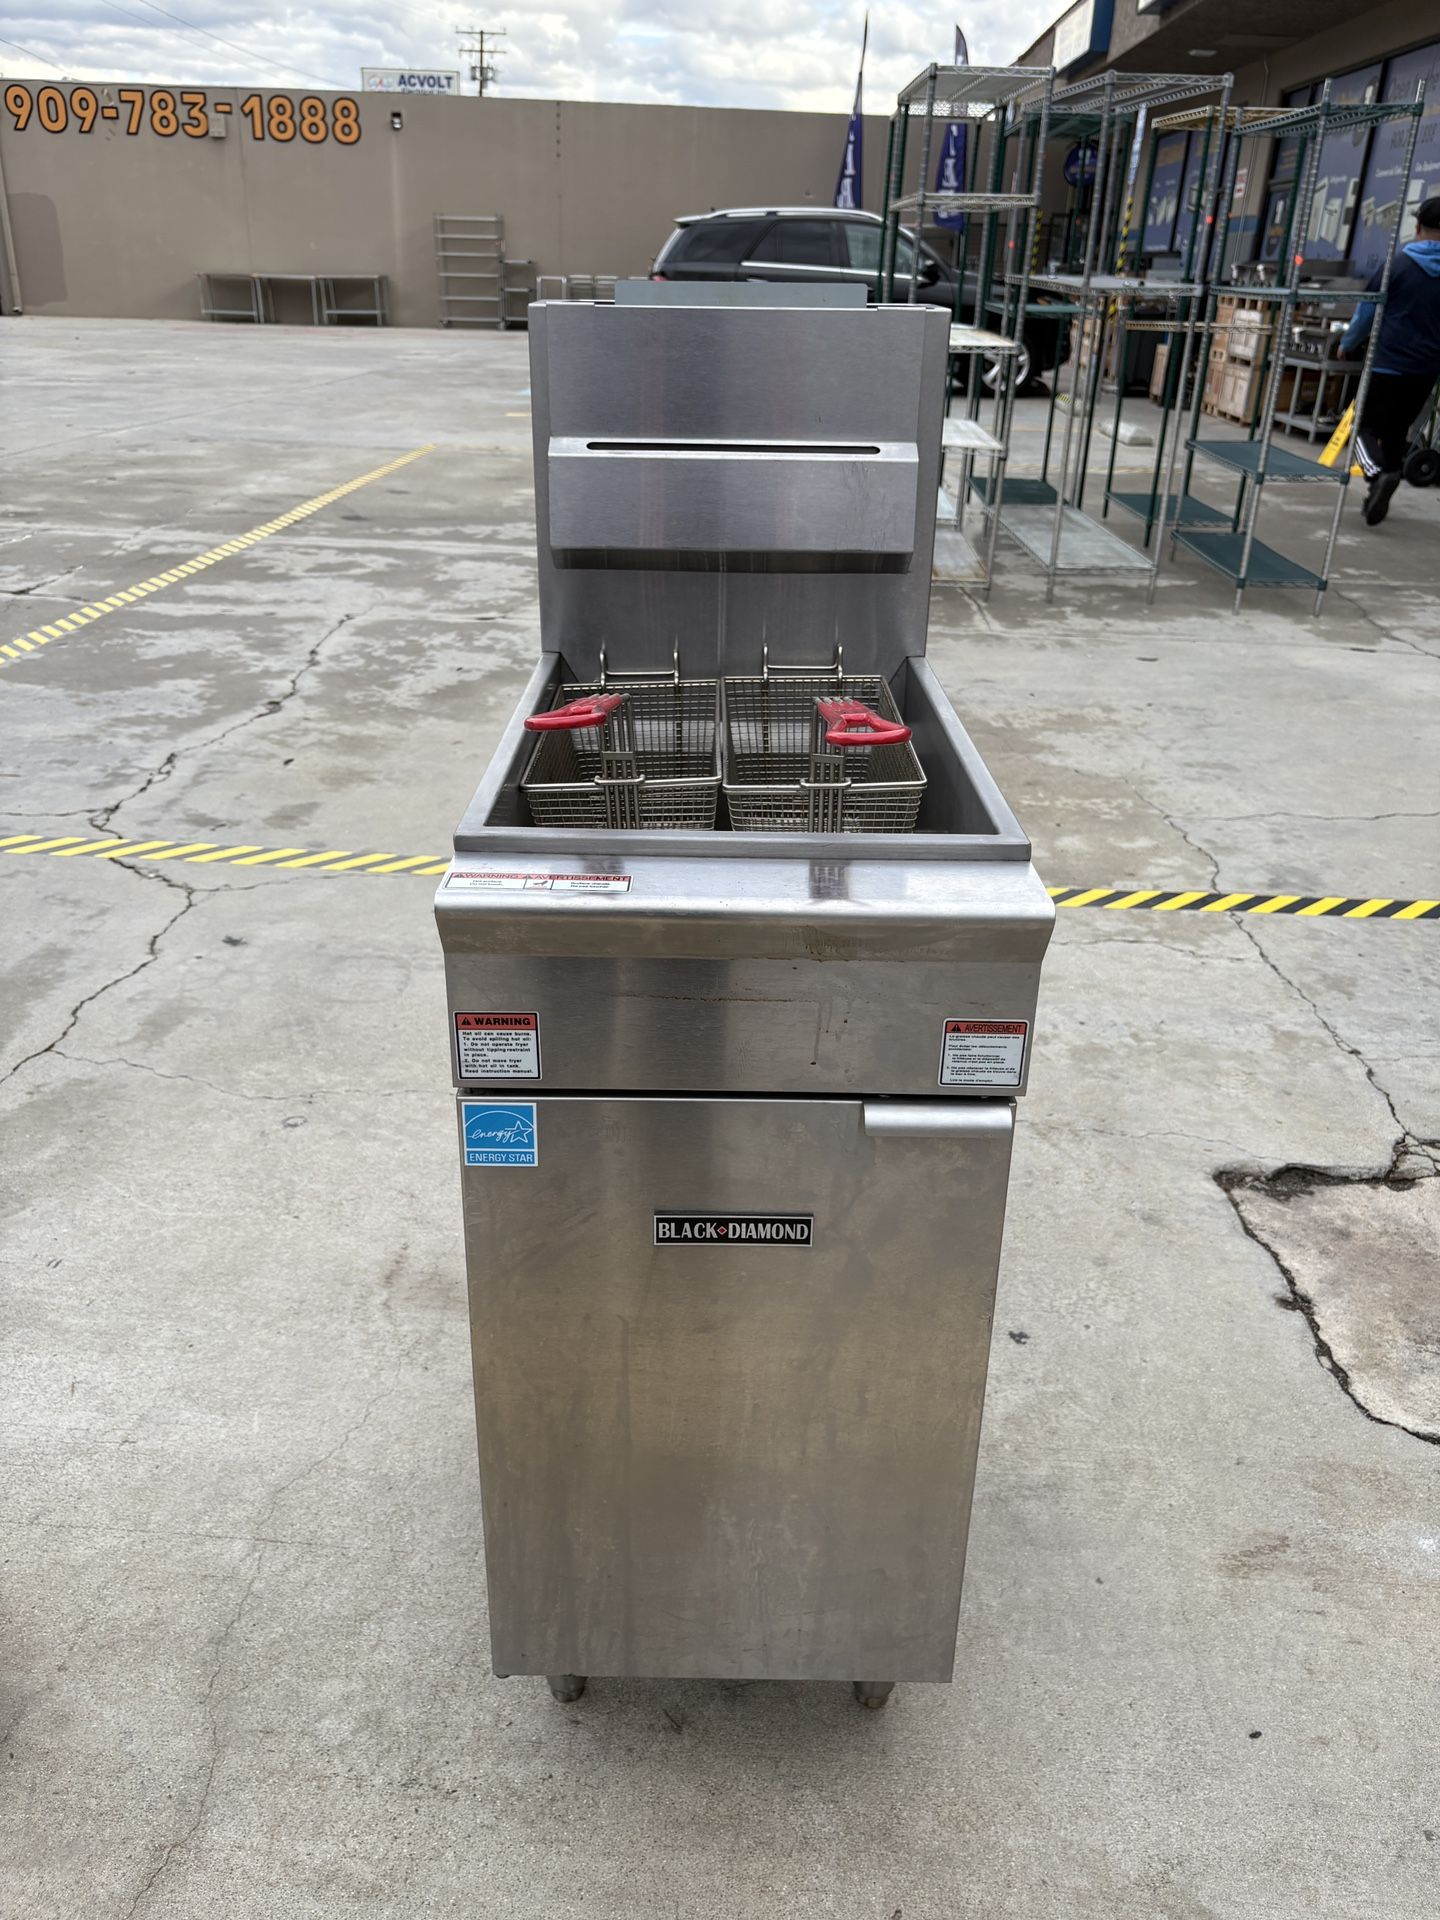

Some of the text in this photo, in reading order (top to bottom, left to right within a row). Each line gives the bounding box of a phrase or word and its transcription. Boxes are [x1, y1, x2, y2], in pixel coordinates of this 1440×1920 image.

[398, 74, 453, 88] ACVOLT
[4, 84, 362, 144] 909-783-1888
[474, 1017, 531, 1026] WARNING
[964, 1024, 1022, 1033] AVERTISSEMENT
[468, 1129, 512, 1143] energy
[470, 1154, 533, 1162] ENERGY STAR
[658, 1222, 809, 1240] BLACK DIAMOND
